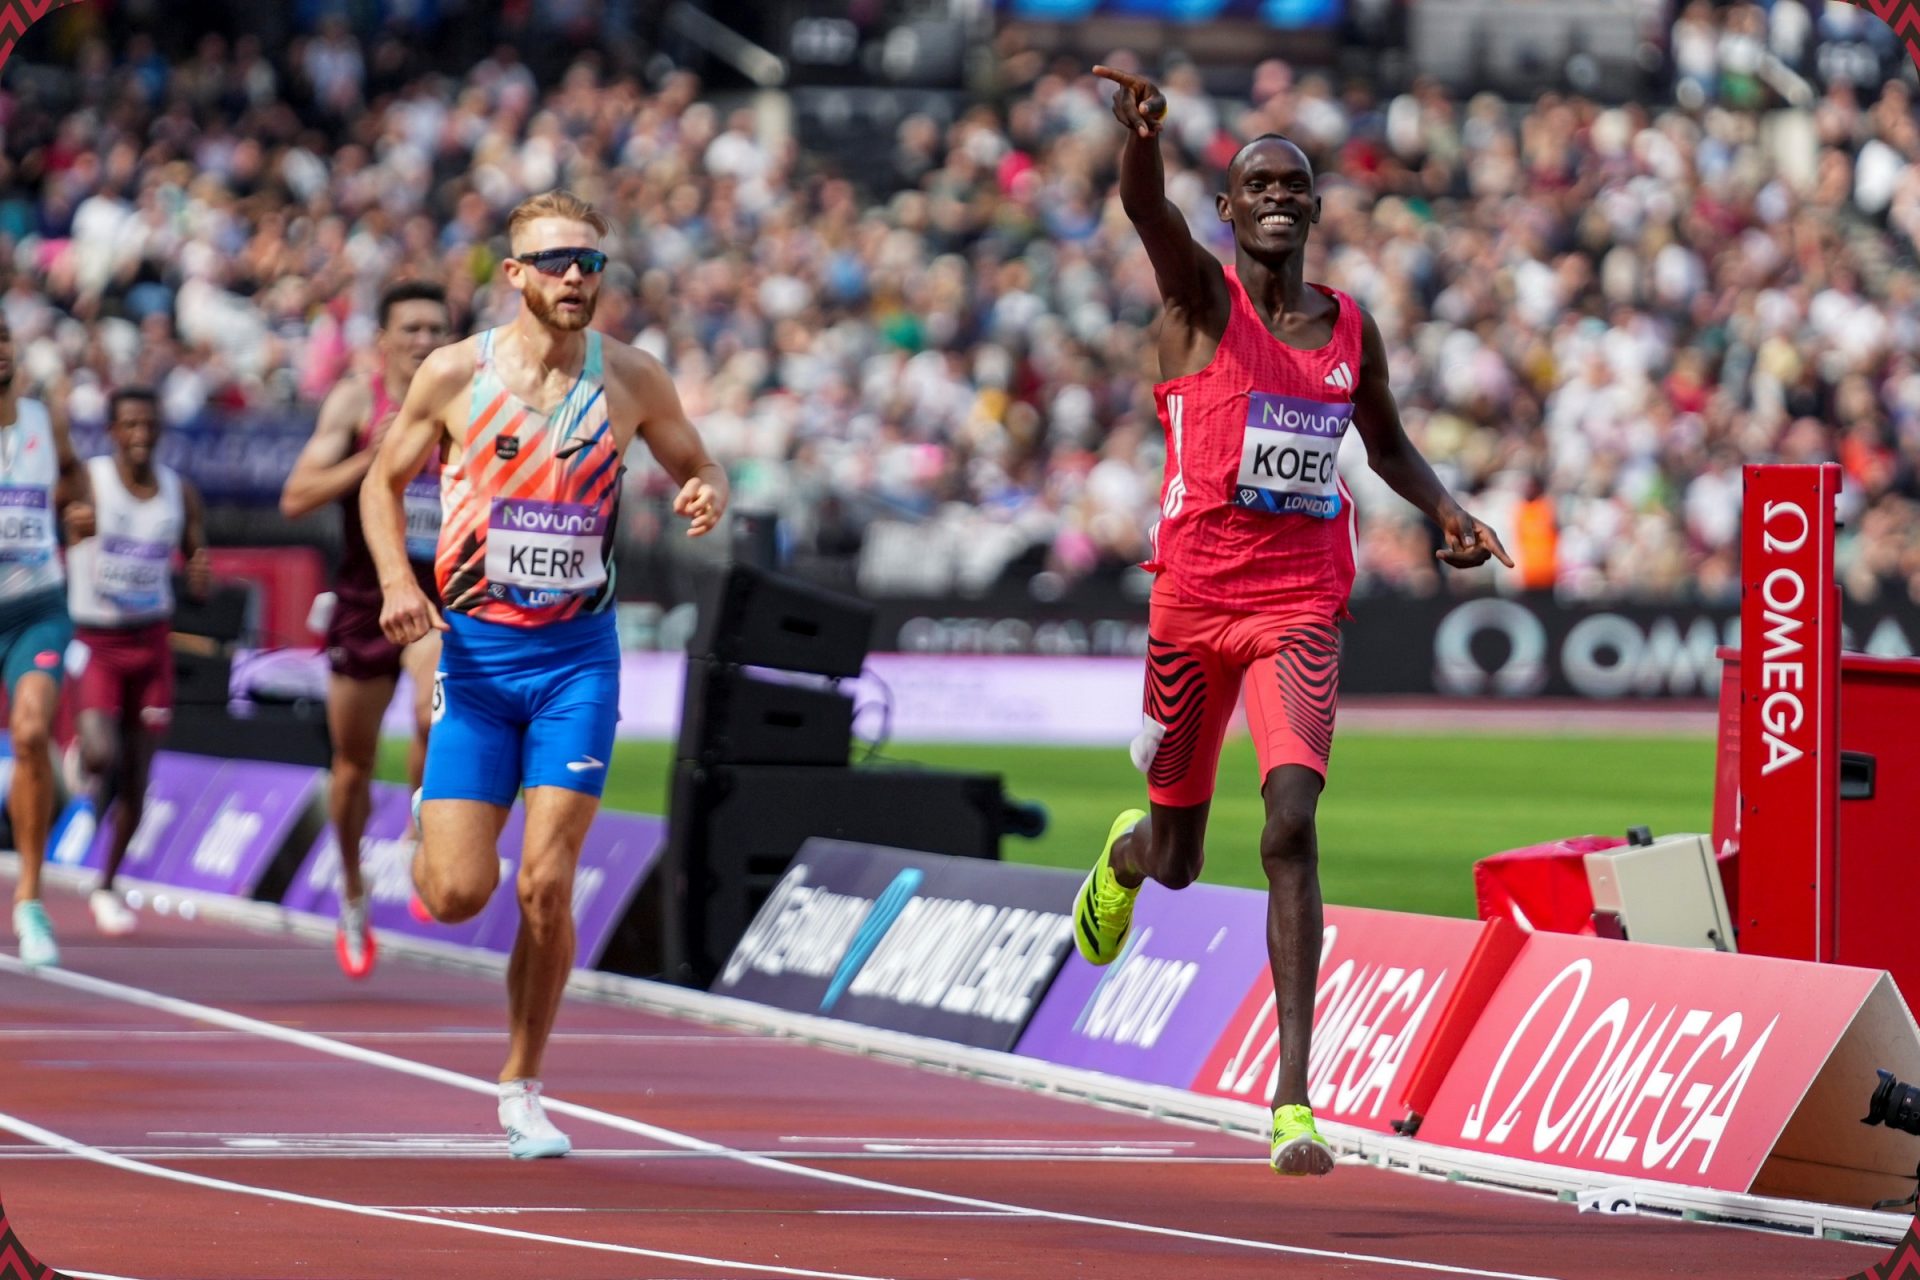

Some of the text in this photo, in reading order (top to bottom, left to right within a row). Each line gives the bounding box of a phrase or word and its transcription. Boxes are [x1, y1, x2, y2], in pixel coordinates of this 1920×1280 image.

[1263, 401, 1349, 433] Novuna
[503, 505, 596, 532] Novuna
[1284, 497, 1335, 513] LONDON
[508, 544, 585, 578] KERR
[1761, 568, 1805, 776] OMEGA
[1532, 997, 1781, 1174] OMEGA
